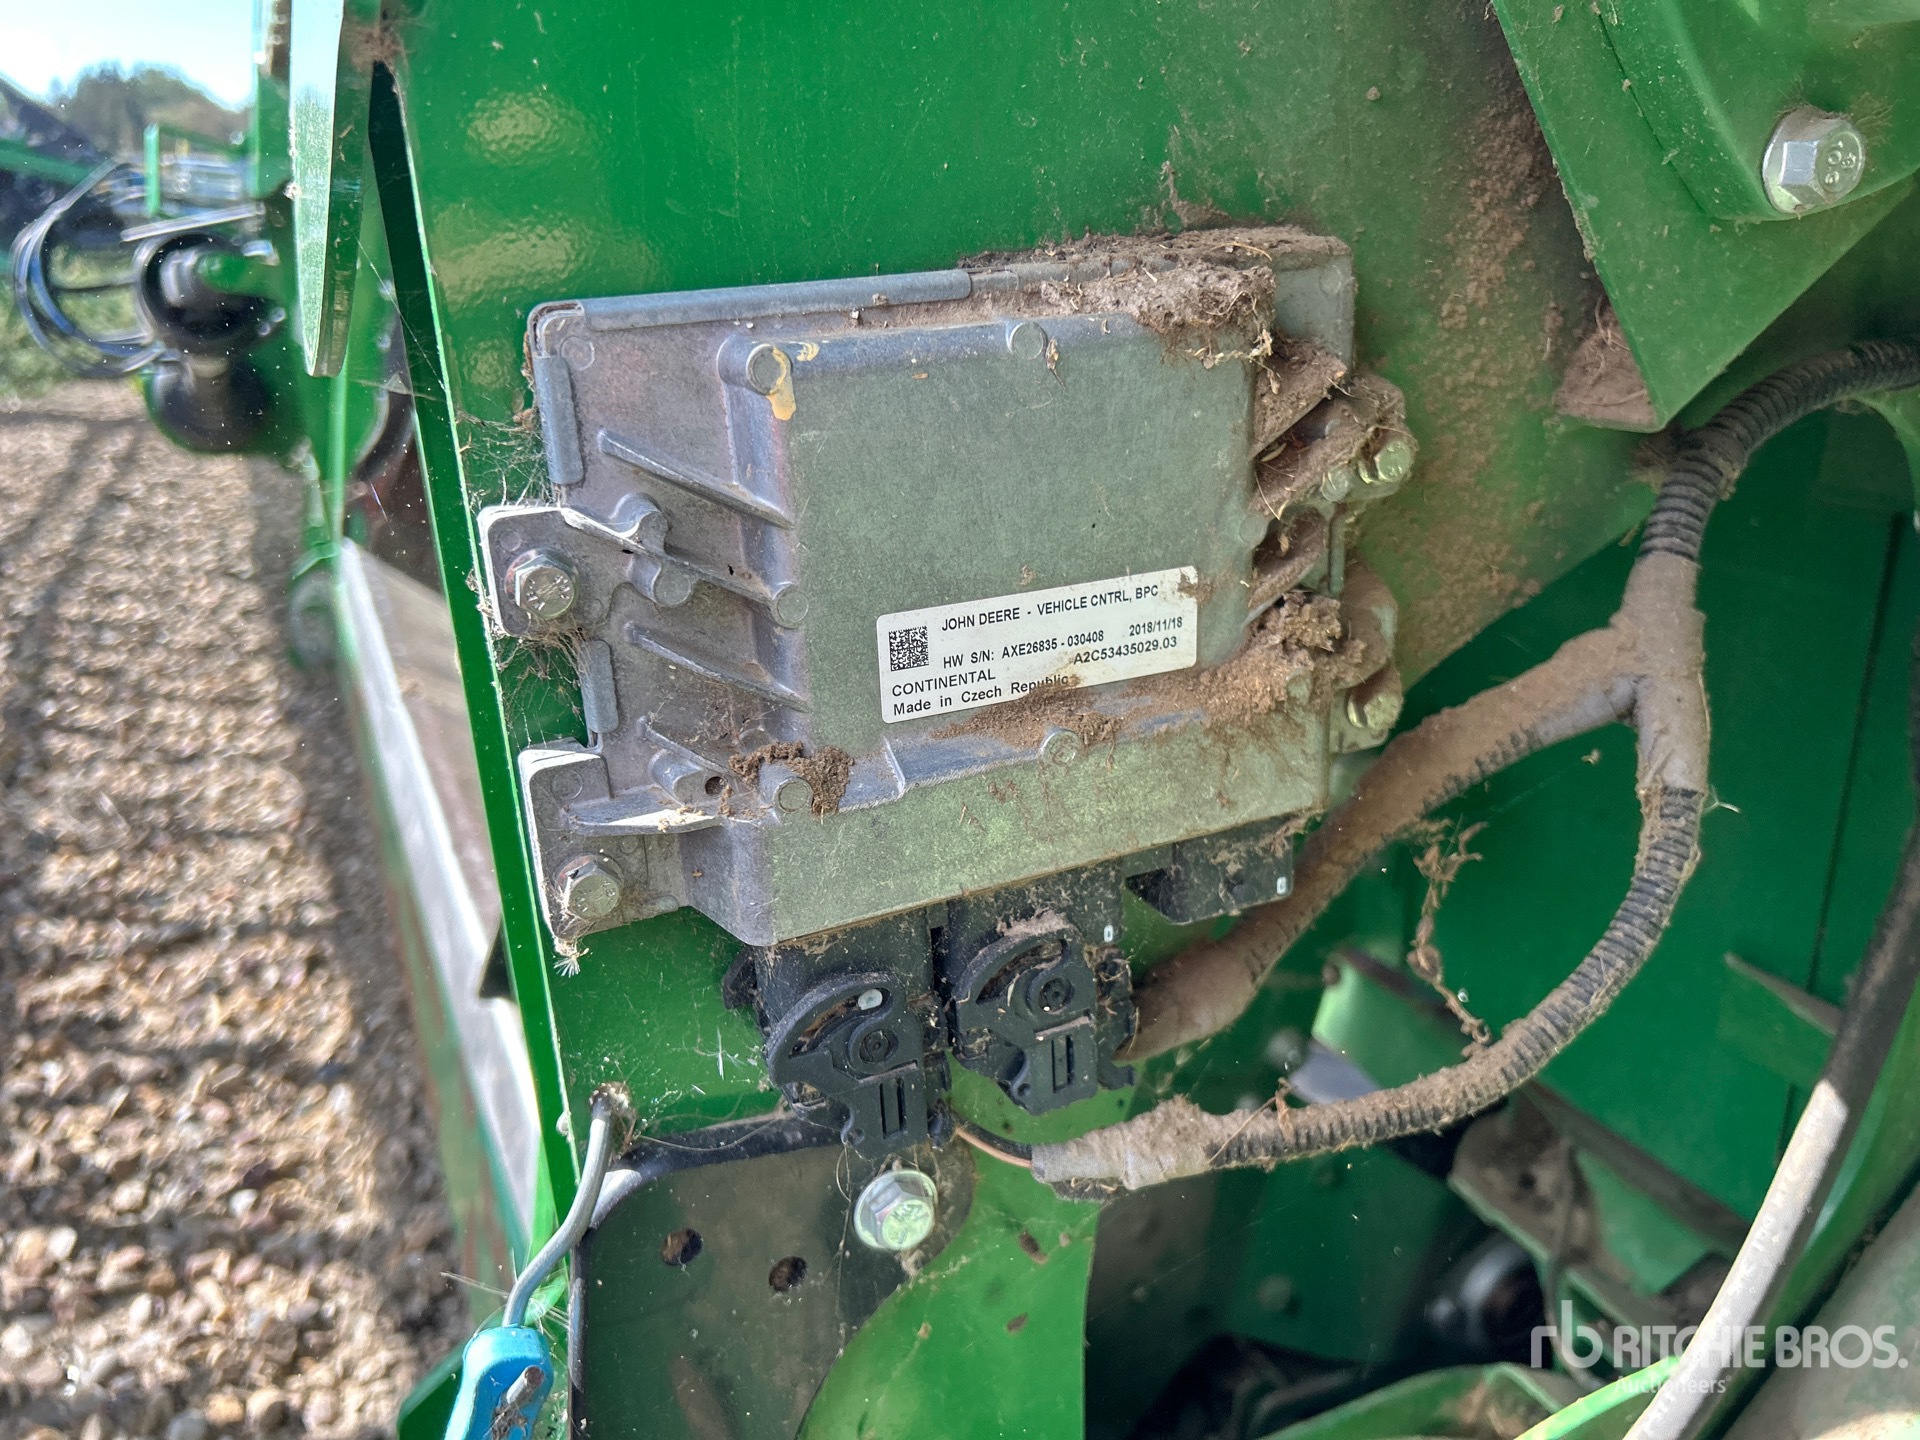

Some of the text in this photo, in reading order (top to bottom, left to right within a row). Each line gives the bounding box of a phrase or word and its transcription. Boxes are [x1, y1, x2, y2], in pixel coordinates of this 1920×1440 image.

[942, 614, 975, 631] JOHN
[979, 607, 1020, 625] DEERE
[1037, 596, 1087, 616] VEHICLE
[1090, 590, 1132, 606] CNTRL,
[1135, 584, 1159, 599] BPC
[892, 636, 1177, 697] CONTINENTAL A2C53435029.03
[943, 653, 963, 669] HW
[970, 649, 994, 663] S/N:
[1002, 638, 1058, 659] AXE26835
[1067, 630, 1104, 647] 030408
[1129, 616, 1183, 637] 2018/11/18
[893, 699, 931, 716] Made
[940, 695, 952, 708] in
[961, 686, 1002, 703] Czech
